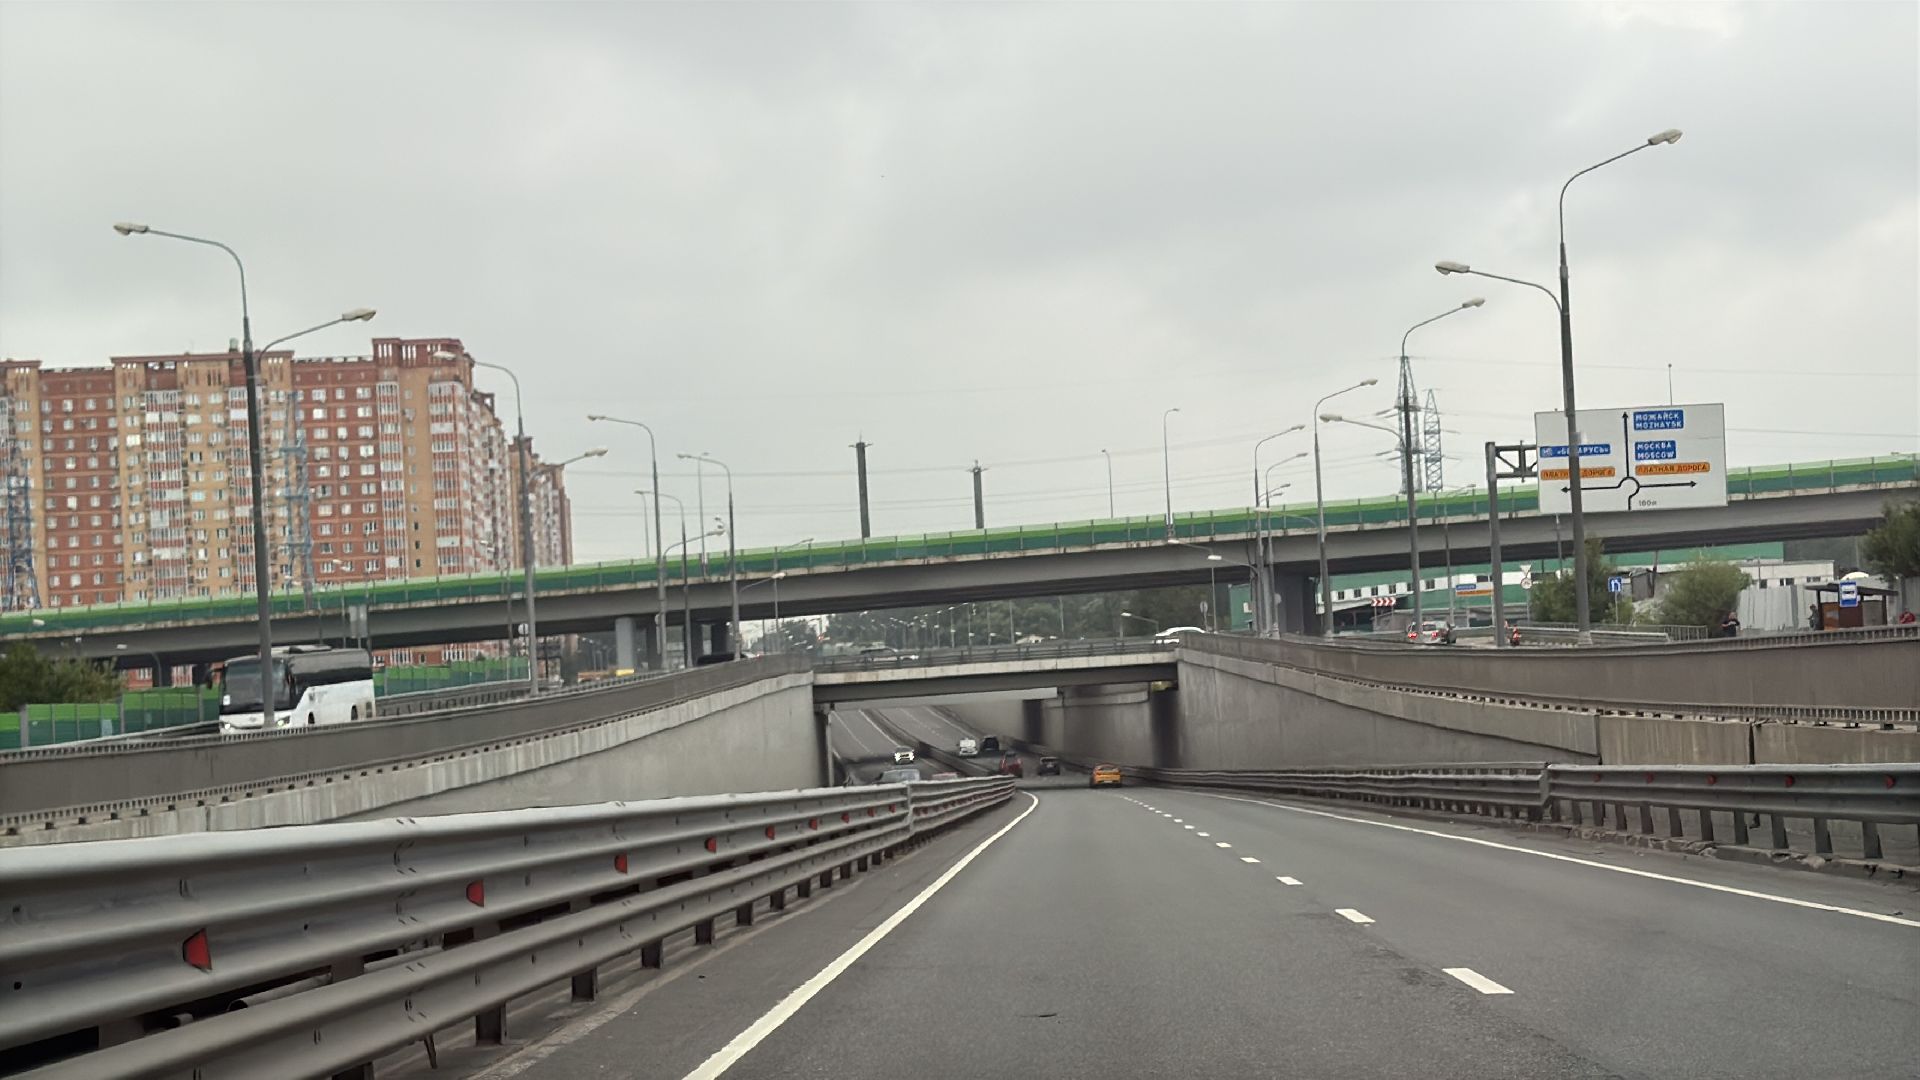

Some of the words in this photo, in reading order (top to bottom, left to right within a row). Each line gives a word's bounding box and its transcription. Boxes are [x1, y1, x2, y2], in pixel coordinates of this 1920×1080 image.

[1635, 412, 1680, 421] МОЖАЙСК
[1637, 442, 1672, 450] МОСКВА
[1637, 451, 1675, 460] MOSCOW
[1677, 463, 1707, 472] ДОРОГА
